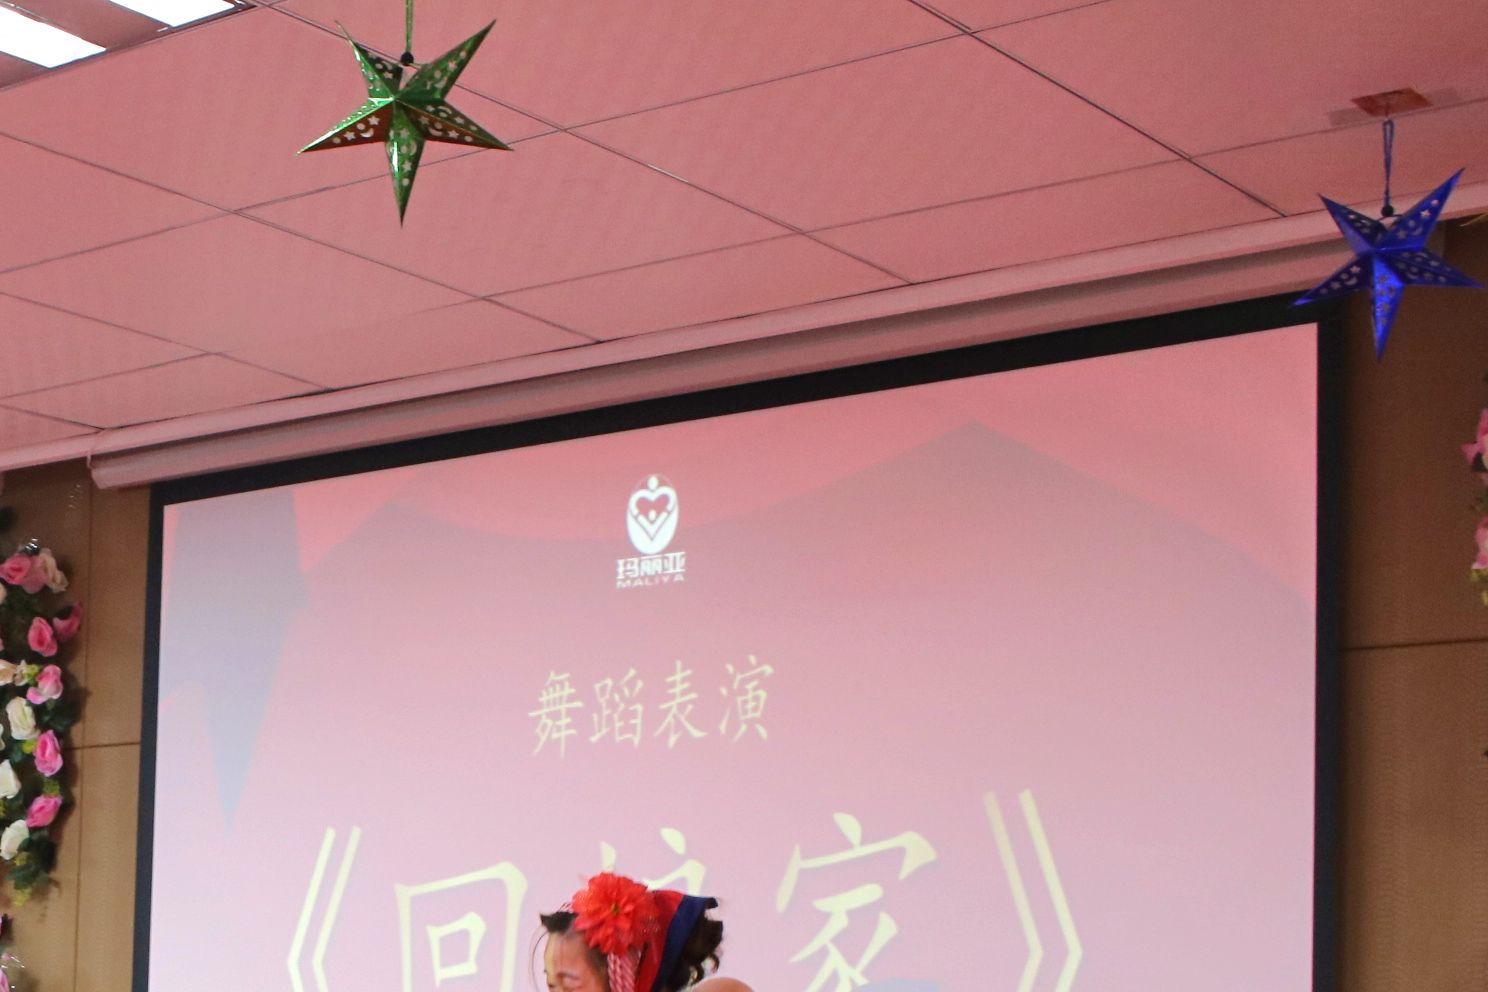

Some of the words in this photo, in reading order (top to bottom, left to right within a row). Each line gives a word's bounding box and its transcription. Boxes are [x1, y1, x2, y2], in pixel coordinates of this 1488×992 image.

[616, 551, 686, 579] 玛丽亚
[616, 574, 684, 590] MALIYA
[528, 655, 774, 757] 舞蹈表演
